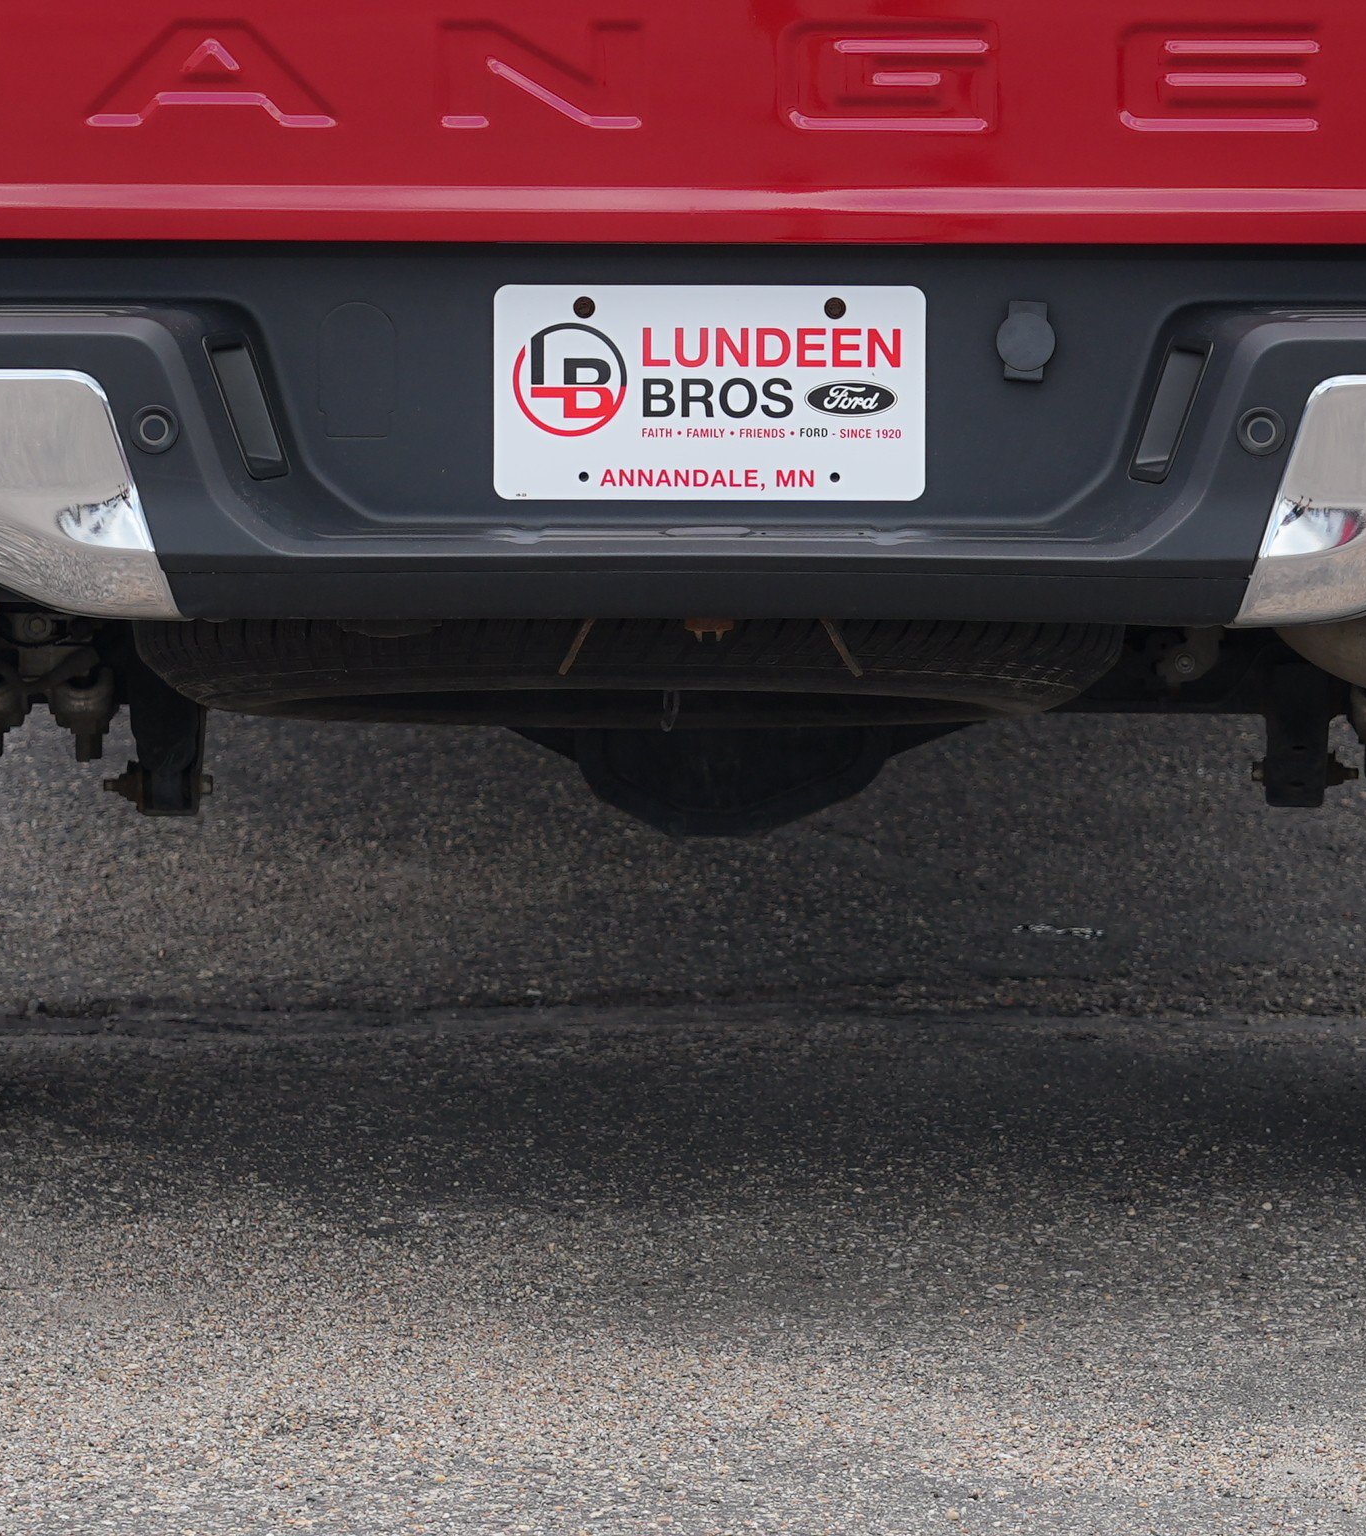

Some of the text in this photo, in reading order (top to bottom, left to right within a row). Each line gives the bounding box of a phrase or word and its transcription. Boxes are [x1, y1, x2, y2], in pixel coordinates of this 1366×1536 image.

[641, 327, 902, 369] LUNDEEN
[642, 377, 795, 419] BROS
[822, 384, 880, 412] Ford
[641, 427, 902, 439] FAITH FAMILY FRIENDS FORD SINCE 1920
[599, 468, 816, 491] ANNANDALE, MN
